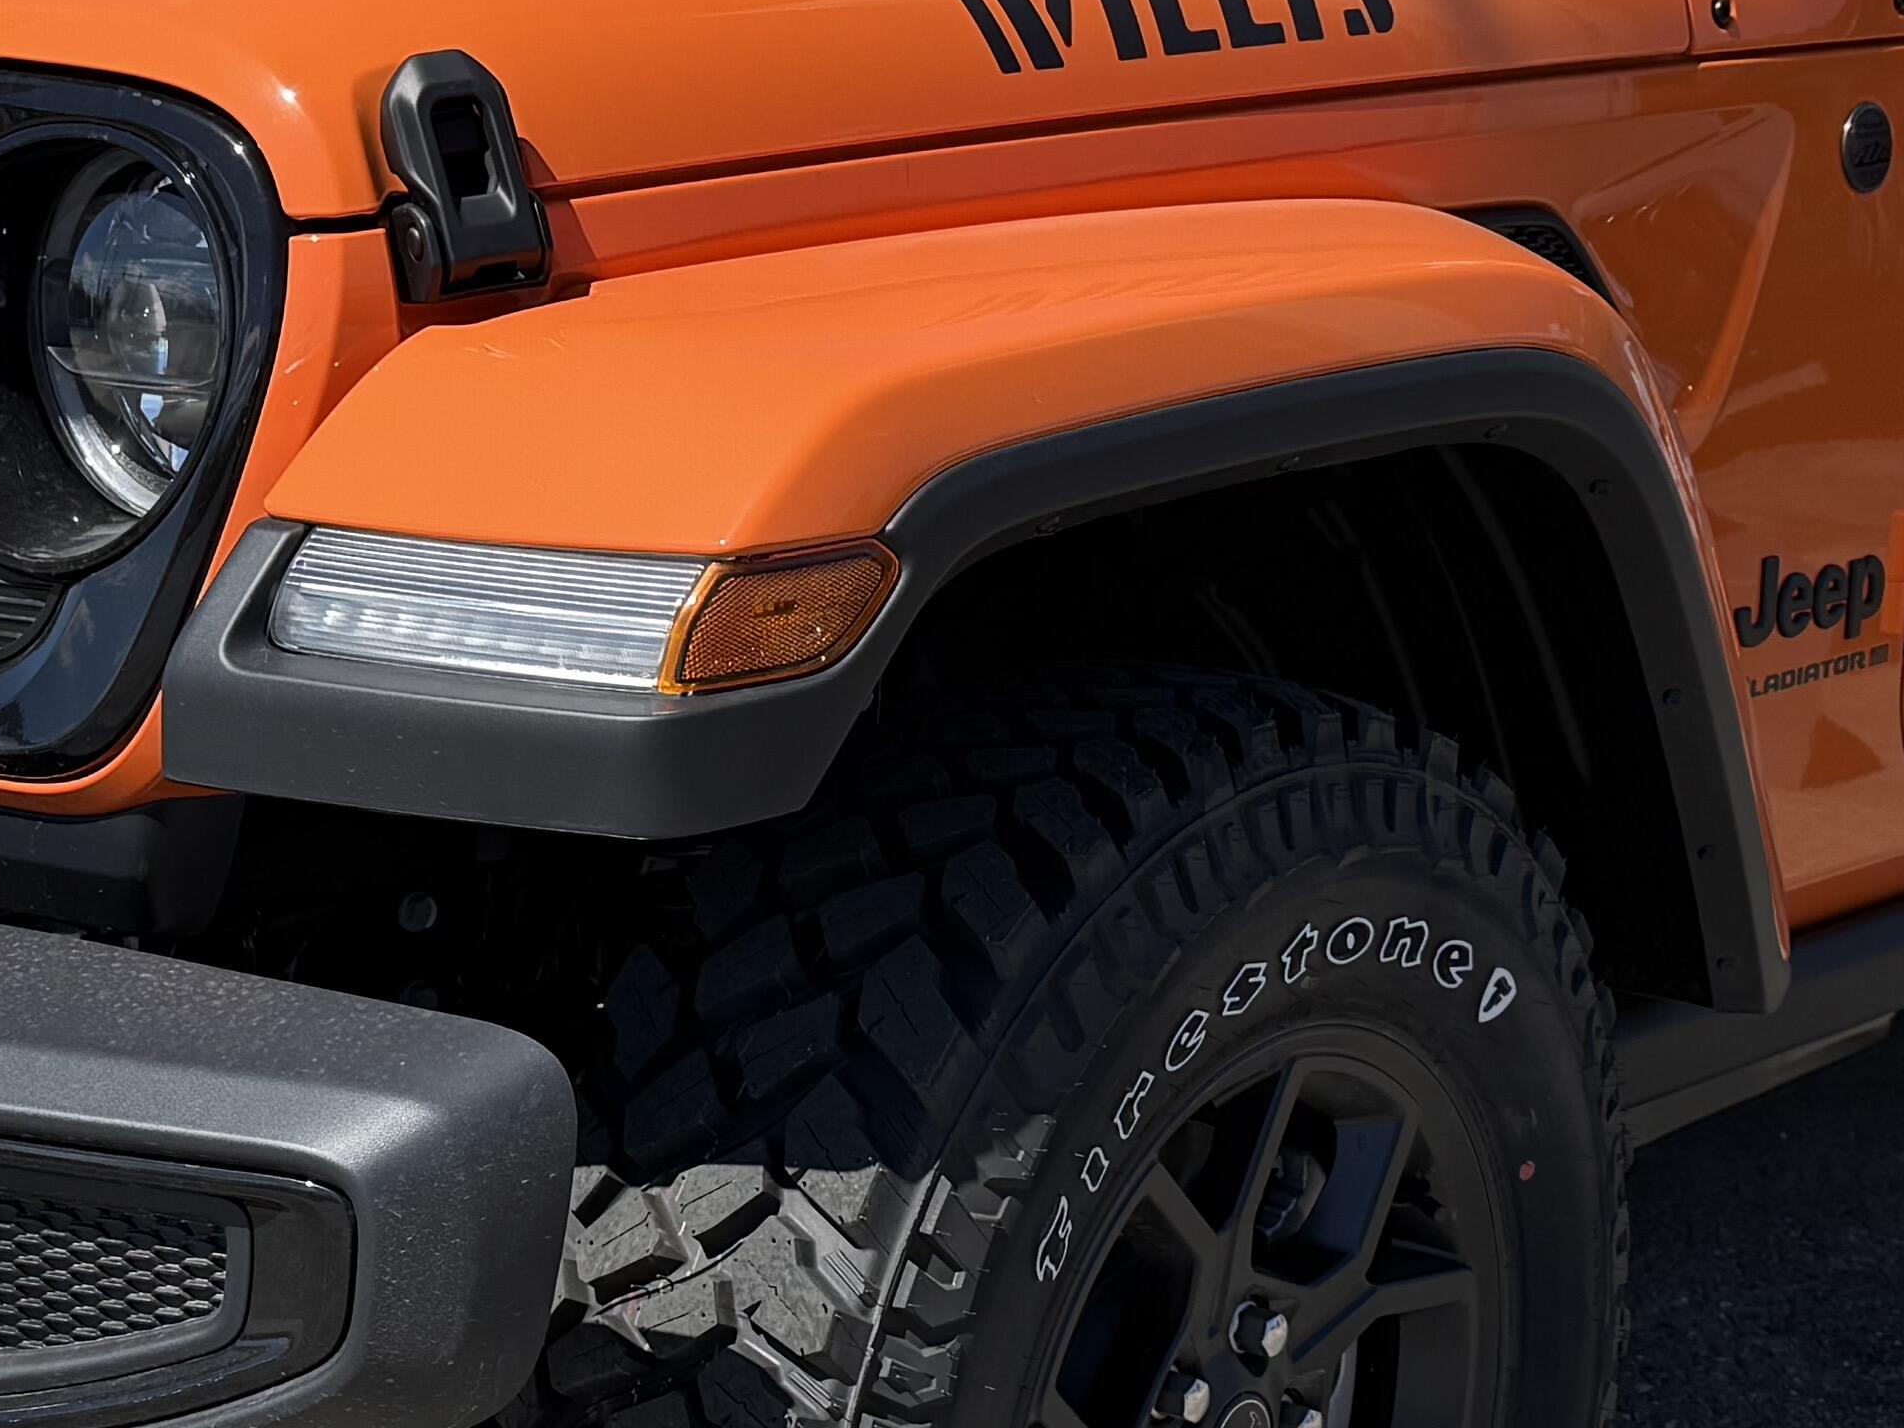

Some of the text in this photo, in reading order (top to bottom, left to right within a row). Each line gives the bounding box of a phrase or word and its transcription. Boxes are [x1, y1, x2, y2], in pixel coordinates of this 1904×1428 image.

[1733, 555, 1886, 648] Jeep
[1747, 651, 1866, 698] LADIATOR
[1036, 916, 1475, 1283] Firestone
